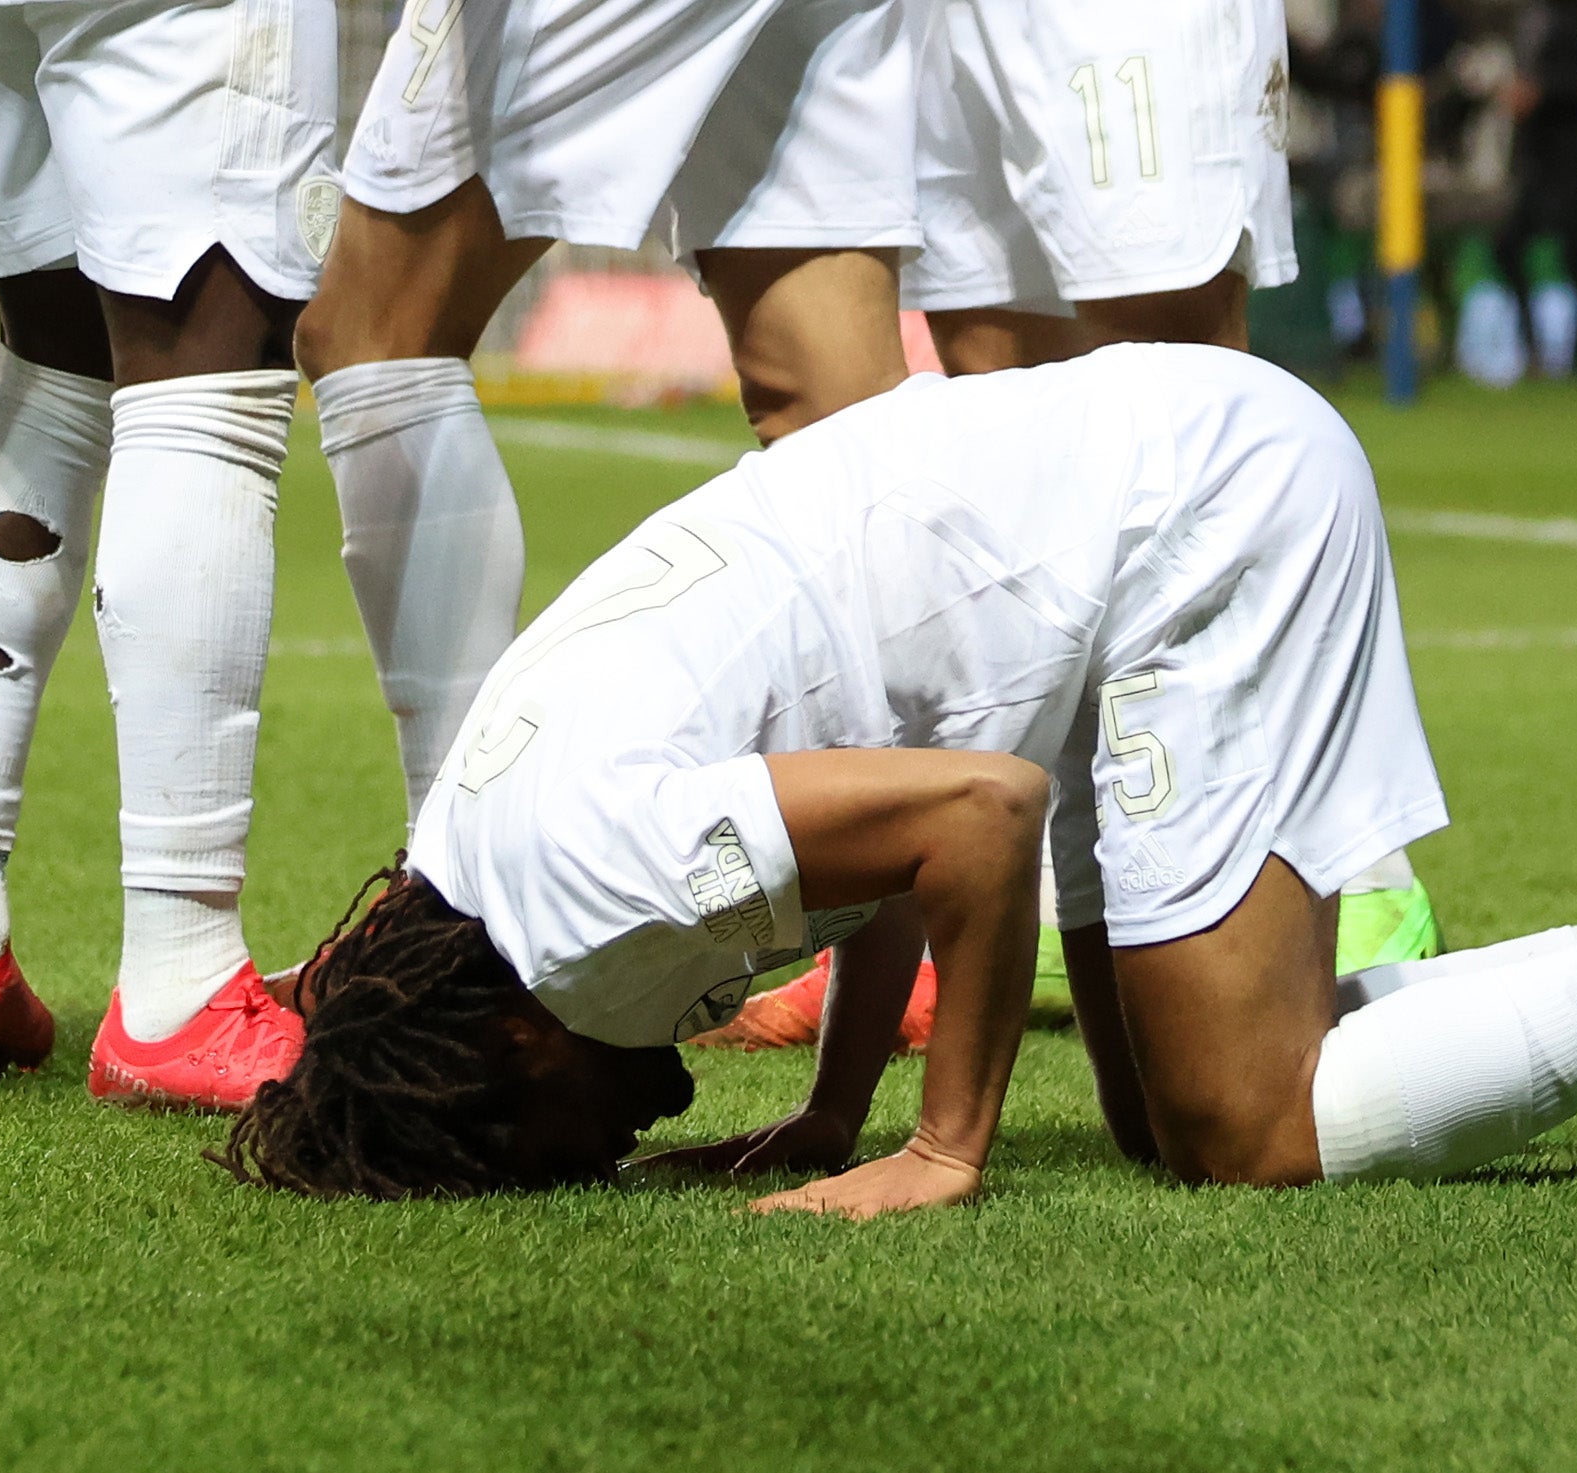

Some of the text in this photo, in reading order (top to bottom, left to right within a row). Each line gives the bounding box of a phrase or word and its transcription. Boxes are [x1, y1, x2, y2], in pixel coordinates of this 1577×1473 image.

[1067, 54, 1162, 189] 11
[686, 869, 741, 945] VISIT
[1117, 867, 1187, 894] adidas
